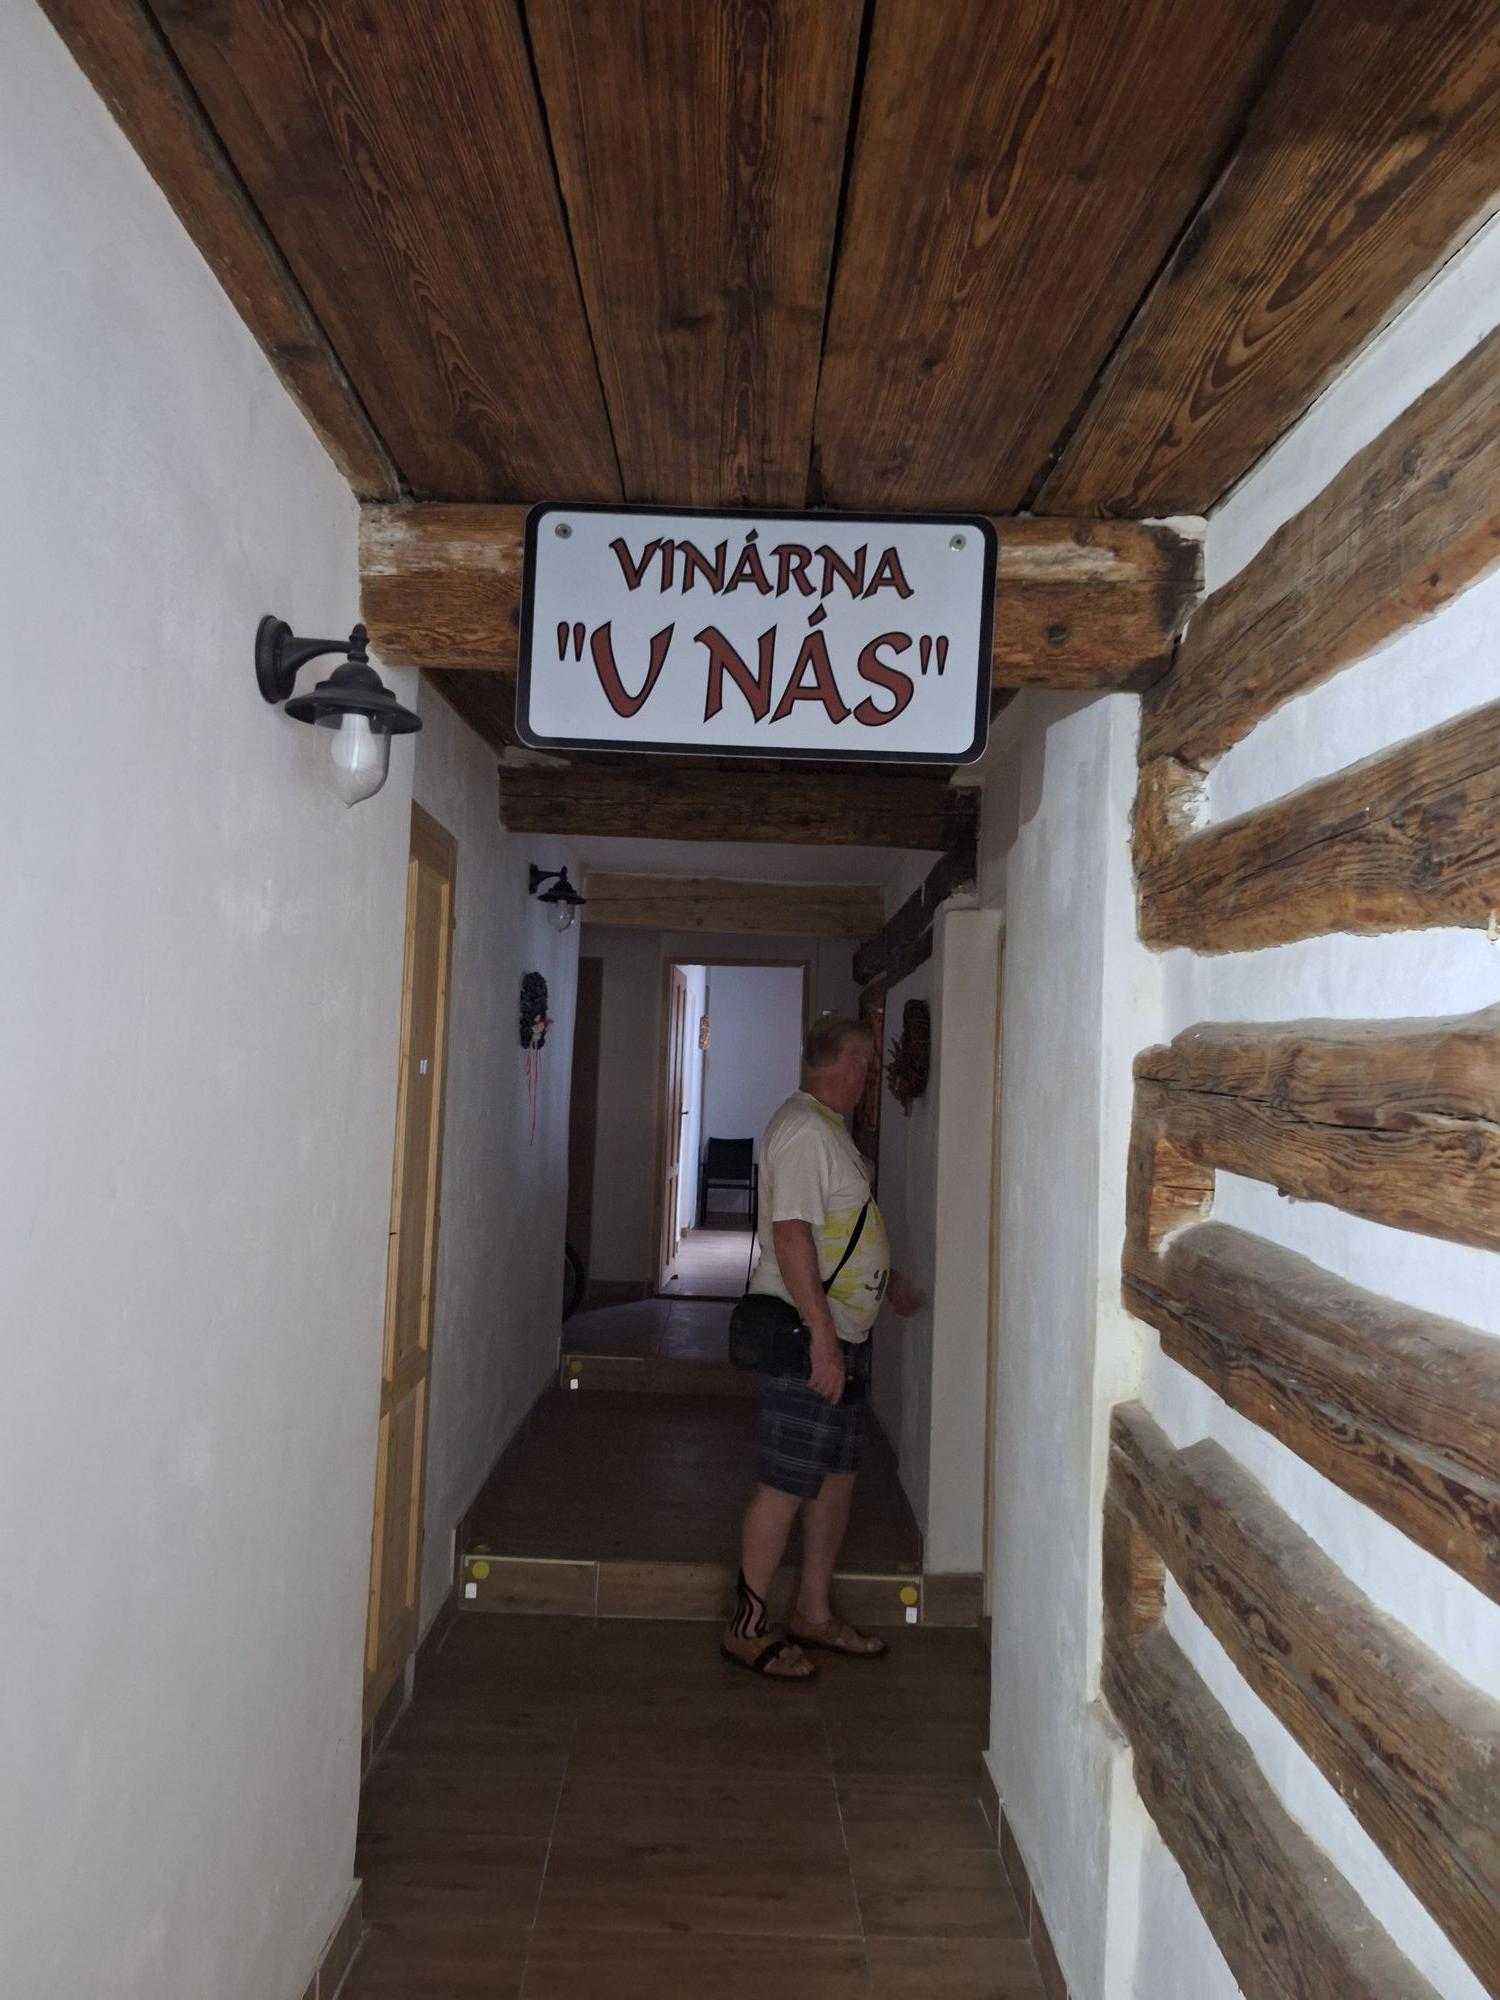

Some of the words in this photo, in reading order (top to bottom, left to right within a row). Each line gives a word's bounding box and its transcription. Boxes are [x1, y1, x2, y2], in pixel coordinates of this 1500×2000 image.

[609, 528, 914, 600] VINÁRNA
[557, 620, 675, 719] "U
[693, 603, 950, 727] NÁS"
